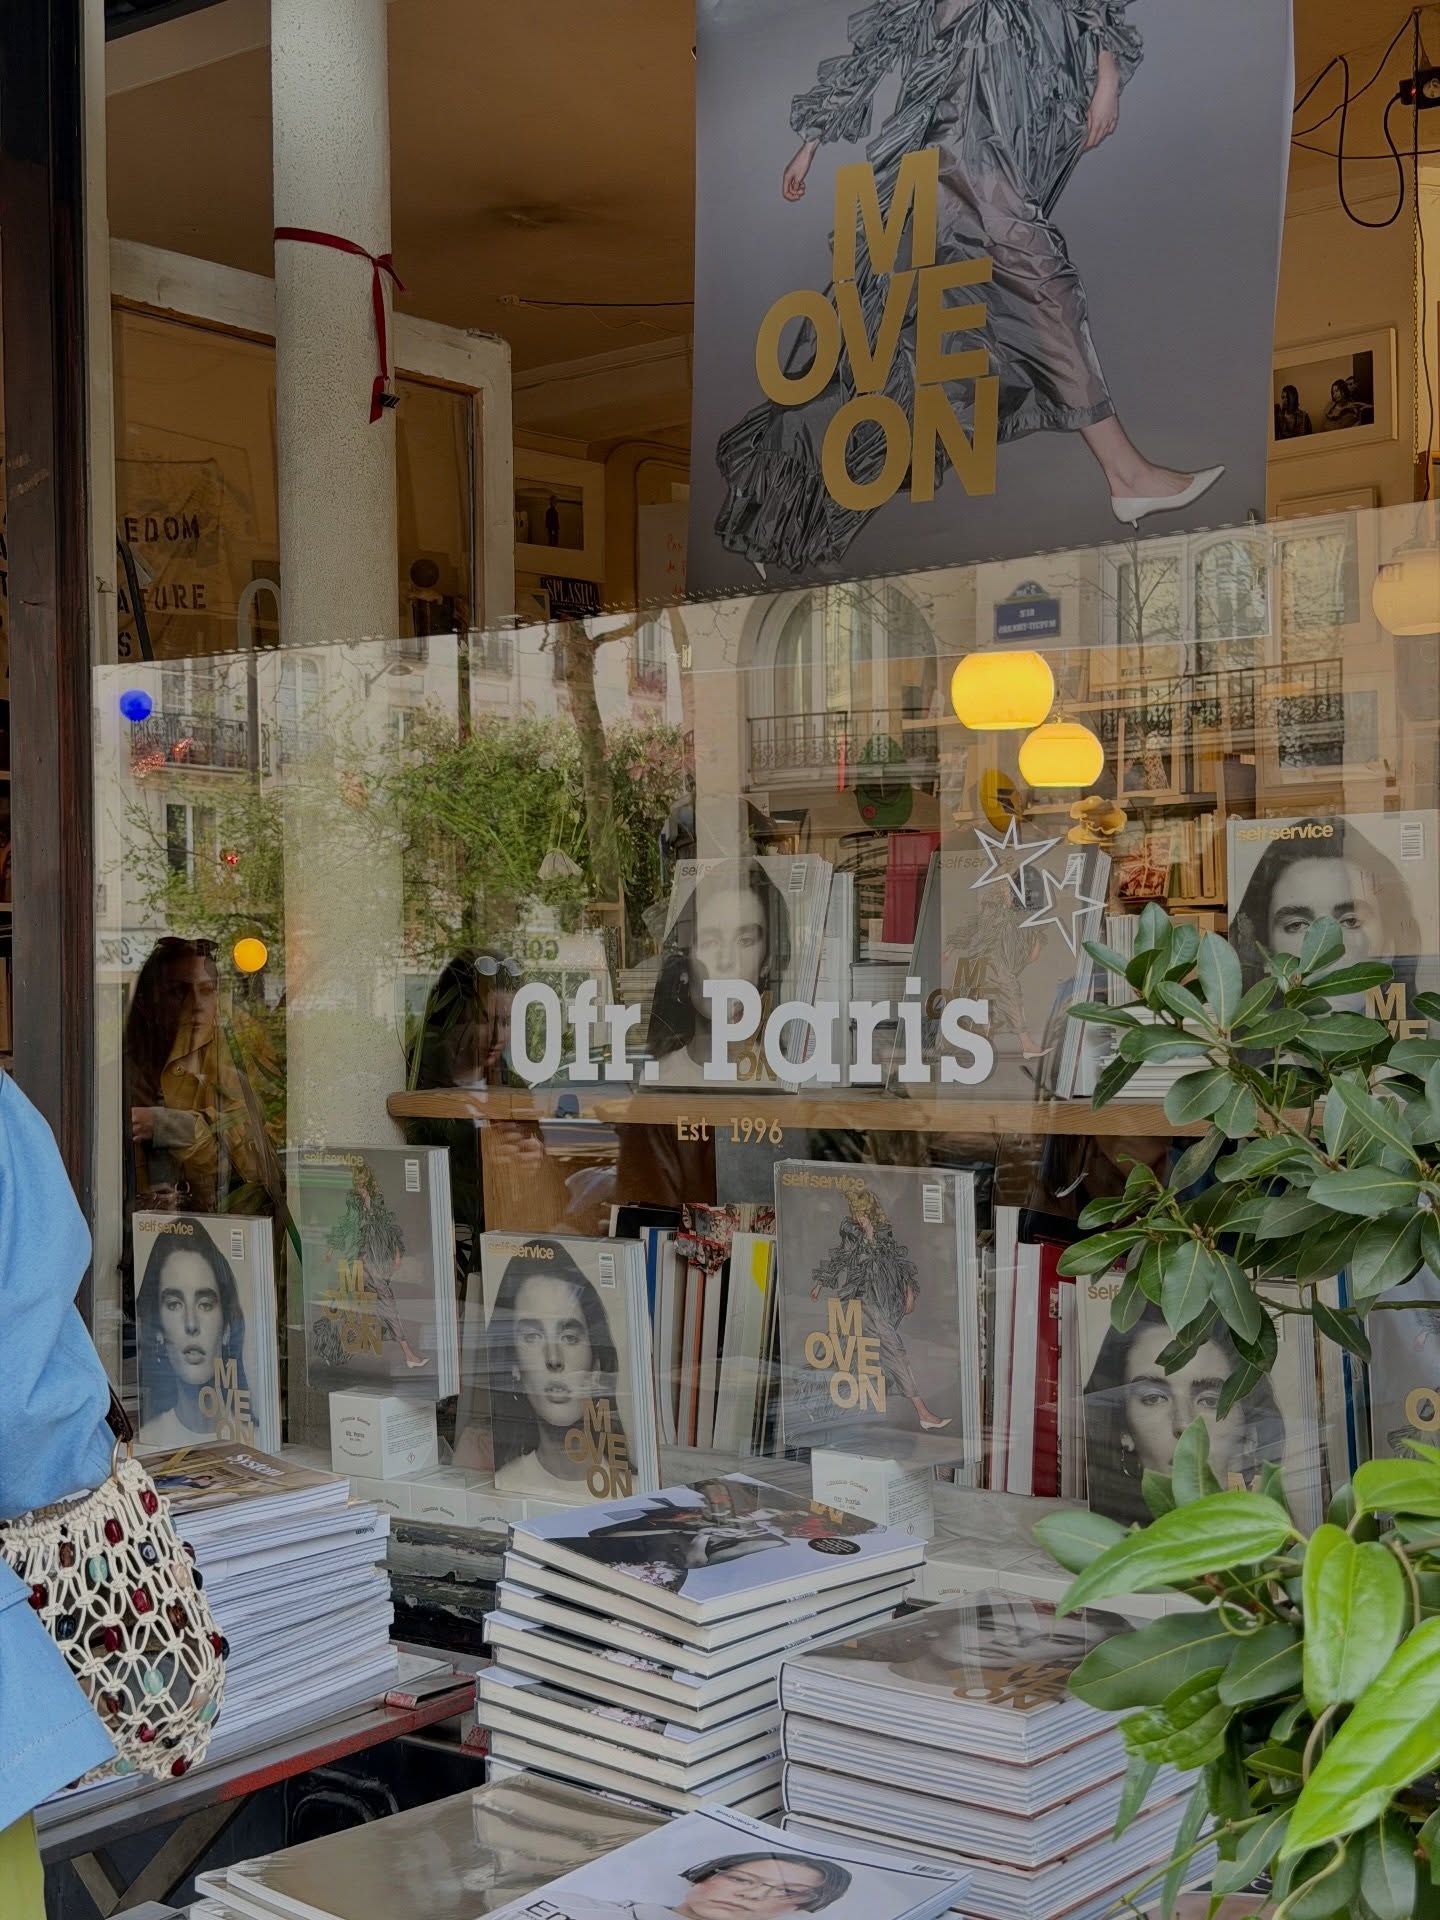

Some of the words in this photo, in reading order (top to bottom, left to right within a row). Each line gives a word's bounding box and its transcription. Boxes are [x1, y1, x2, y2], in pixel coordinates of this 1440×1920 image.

[833, 147, 940, 283] M
[756, 256, 993, 406] OVE
[821, 375, 999, 511] ON
[1268, 823, 1334, 840] service
[1365, 982, 1407, 1020] M
[511, 979, 661, 1089] Ofr.
[702, 976, 995, 1085] Paris
[677, 1116, 710, 1142] Est
[730, 1116, 783, 1145] 1996
[810, 1175, 865, 1191] service
[158, 1221, 194, 1236] service
[511, 1244, 554, 1260] service
[338, 1259, 364, 1291] M
[828, 1297, 862, 1336] M
[805, 1331, 882, 1375] OVE
[214, 1358, 237, 1389] M
[199, 1386, 251, 1421] OVE
[831, 1371, 886, 1412] ON
[583, 1397, 610, 1432] M
[227, 1453, 286, 1478] System
[565, 1428, 629, 1470] OVE
[586, 1466, 632, 1499] ON
